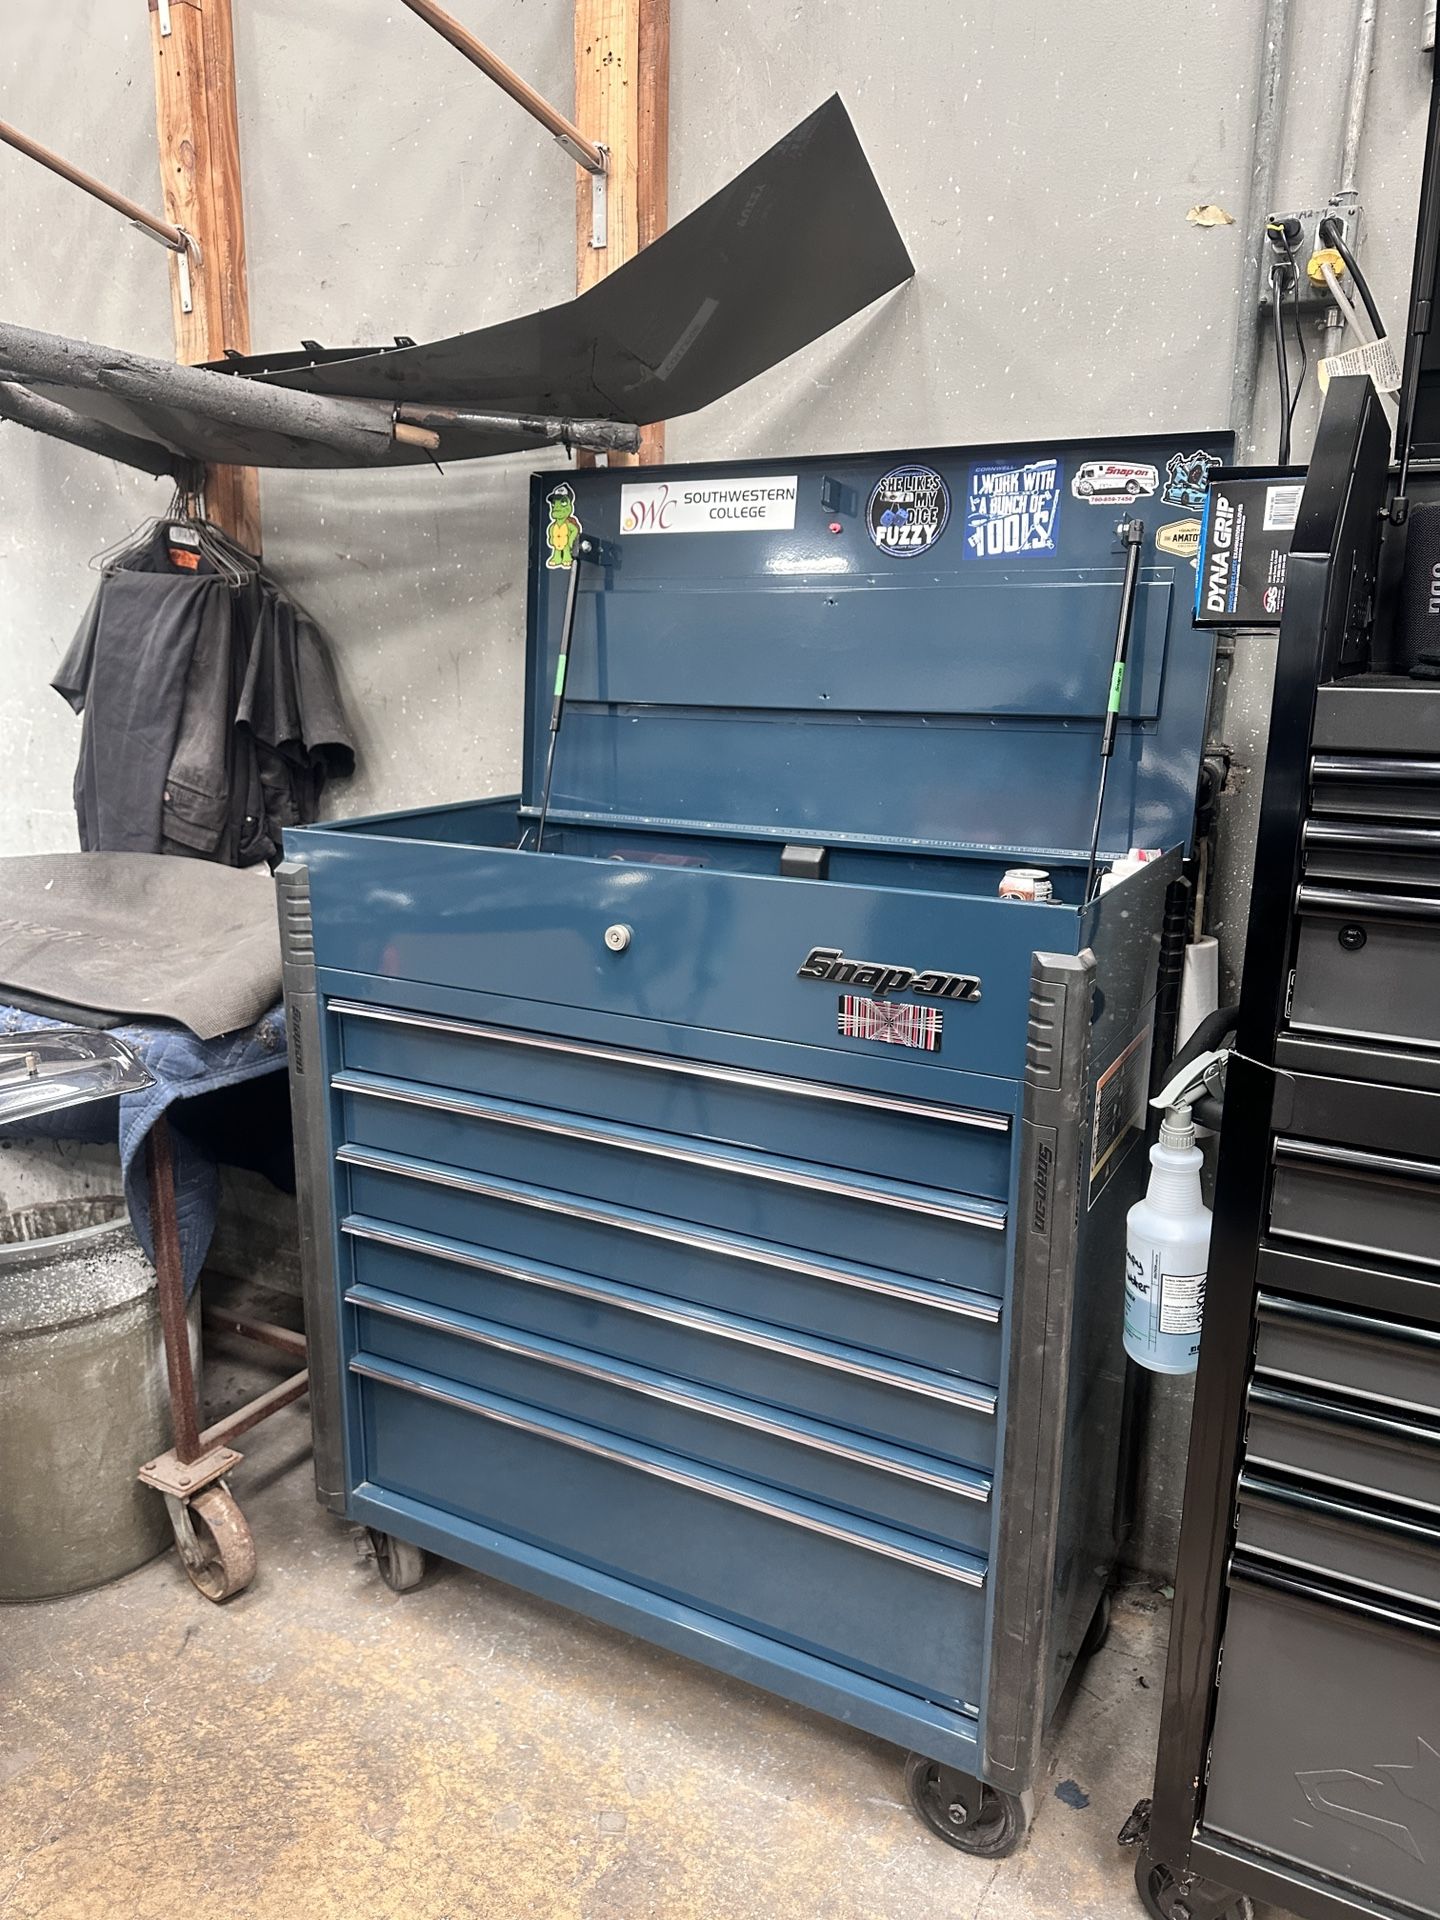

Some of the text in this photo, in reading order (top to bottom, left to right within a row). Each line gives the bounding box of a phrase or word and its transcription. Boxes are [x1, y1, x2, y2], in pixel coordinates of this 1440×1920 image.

[973, 470, 1056, 495] I WORK WITH
[1104, 466, 1149, 477] Snap-on
[880, 475, 941, 493] SHE LIKES
[684, 488, 795, 504] SOUTHWESTERN
[914, 490, 938, 508] MY
[979, 494, 1046, 515] A BUNCH OF
[622, 484, 678, 532] SWC
[709, 506, 767, 520] COLLEGE
[905, 507, 939, 525] DICE
[875, 524, 937, 546] FUZZY
[975, 511, 1050, 557] TOOLS
[1207, 497, 1235, 613] DYNA GRIP
[1267, 586, 1278, 613] SAS
[797, 946, 981, 1002] Snap-on
[292, 1005, 305, 1074] Snap-on
[1034, 1141, 1053, 1231] Snap-on
